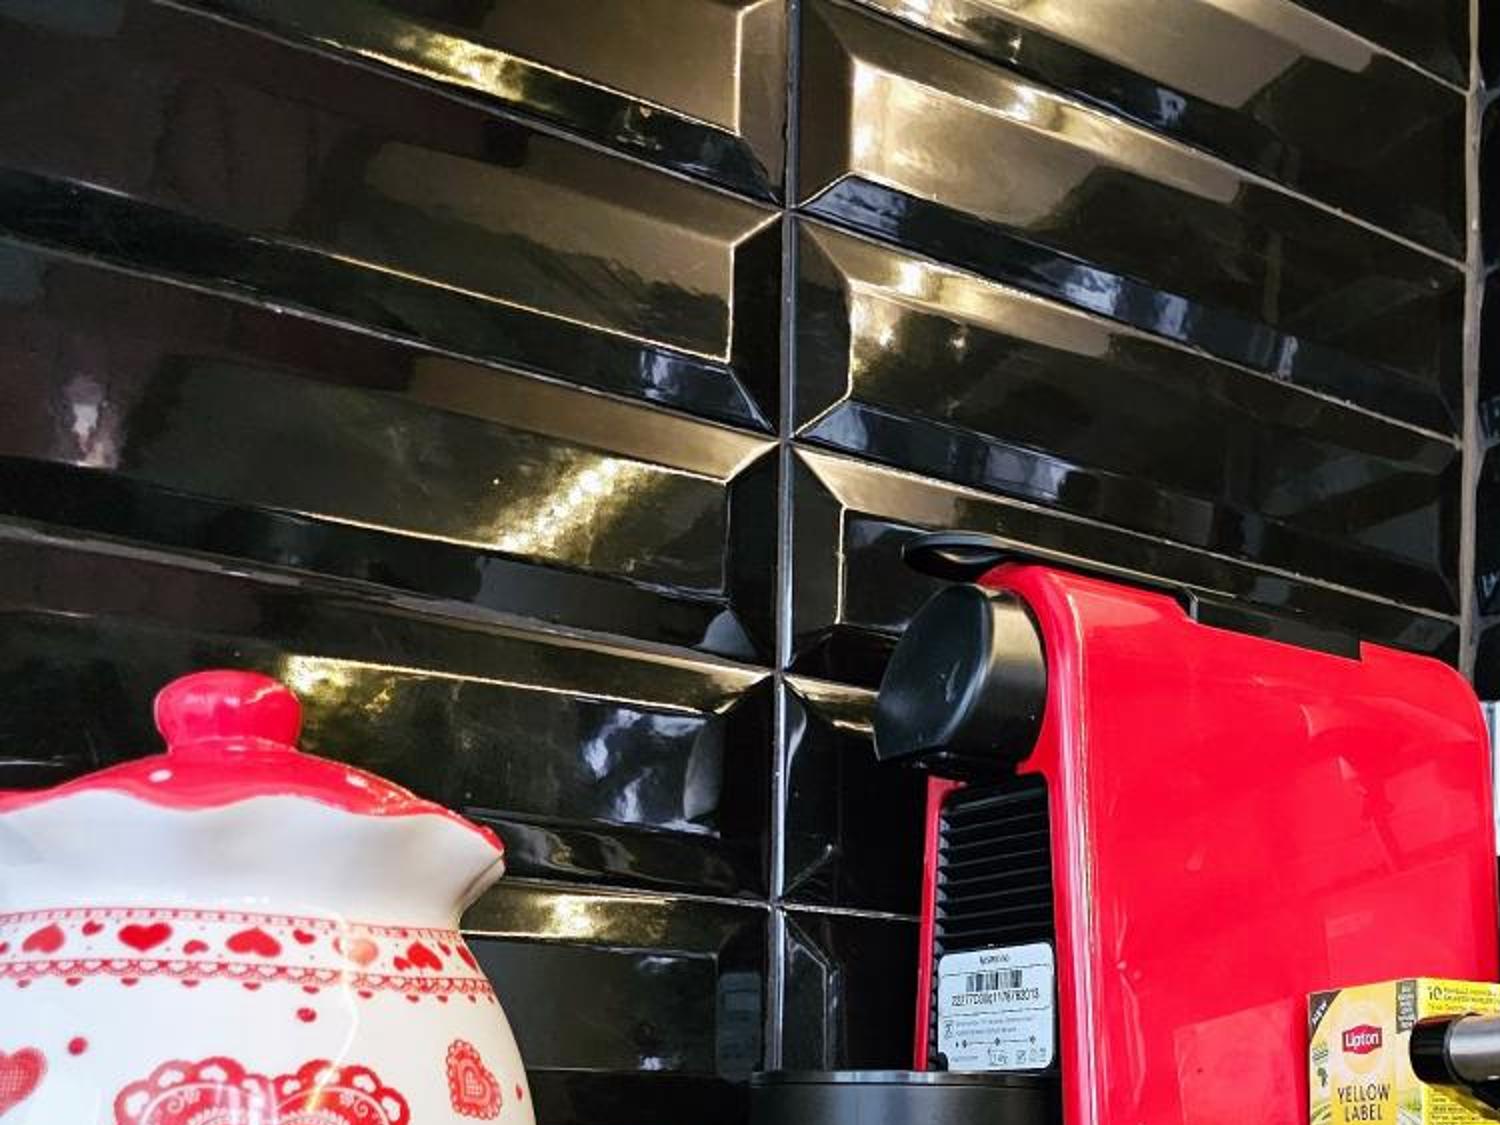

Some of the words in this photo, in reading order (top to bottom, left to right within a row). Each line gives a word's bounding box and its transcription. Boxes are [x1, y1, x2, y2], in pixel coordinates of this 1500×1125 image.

[1345, 1031, 1380, 1051] Lipton
[1337, 1083, 1391, 1105] YELLOW
[1344, 1103, 1384, 1123] LABEL
